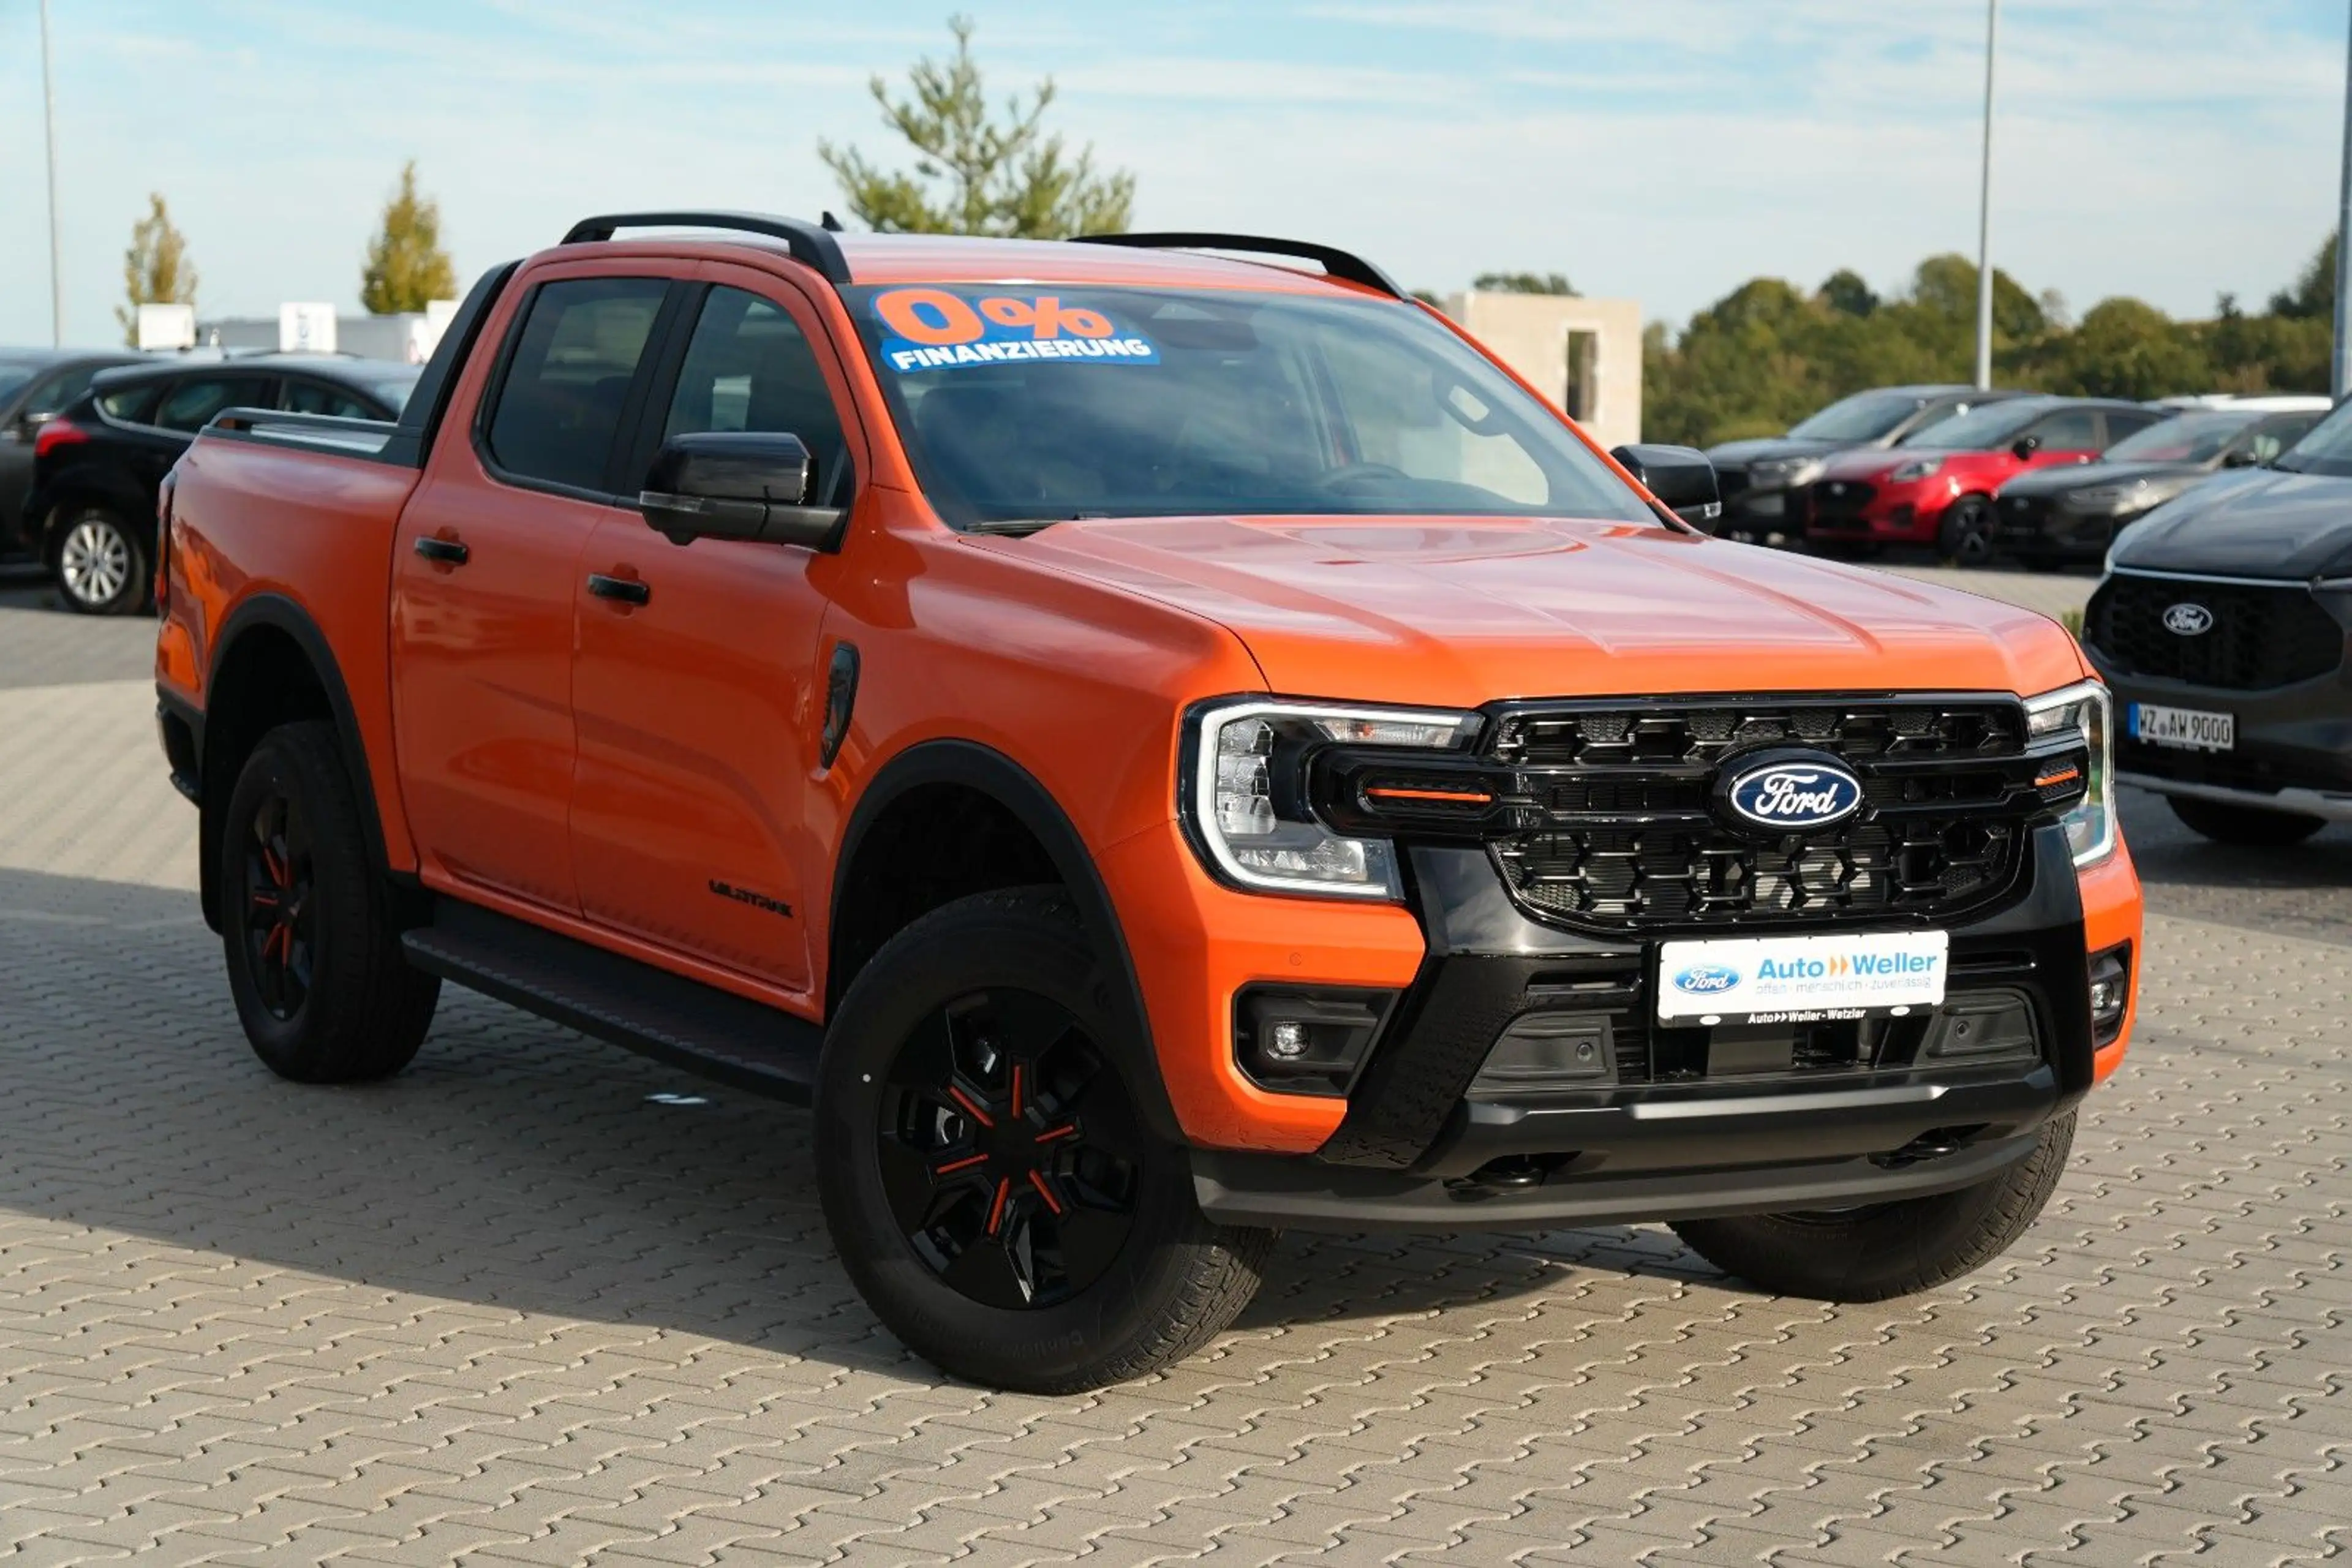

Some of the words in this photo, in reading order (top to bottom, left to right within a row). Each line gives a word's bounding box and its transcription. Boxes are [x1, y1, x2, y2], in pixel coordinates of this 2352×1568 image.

[876, 288, 1114, 344] 0%
[891, 339, 1152, 371] FINANZIERUNG
[2191, 715, 2231, 744] 9000
[1755, 773, 1838, 815] Ford
[1684, 967, 1730, 990] Ford
[1757, 958, 1824, 979] Auto
[1852, 952, 1937, 975] Weller
[1747, 1013, 1774, 1023] Auto
